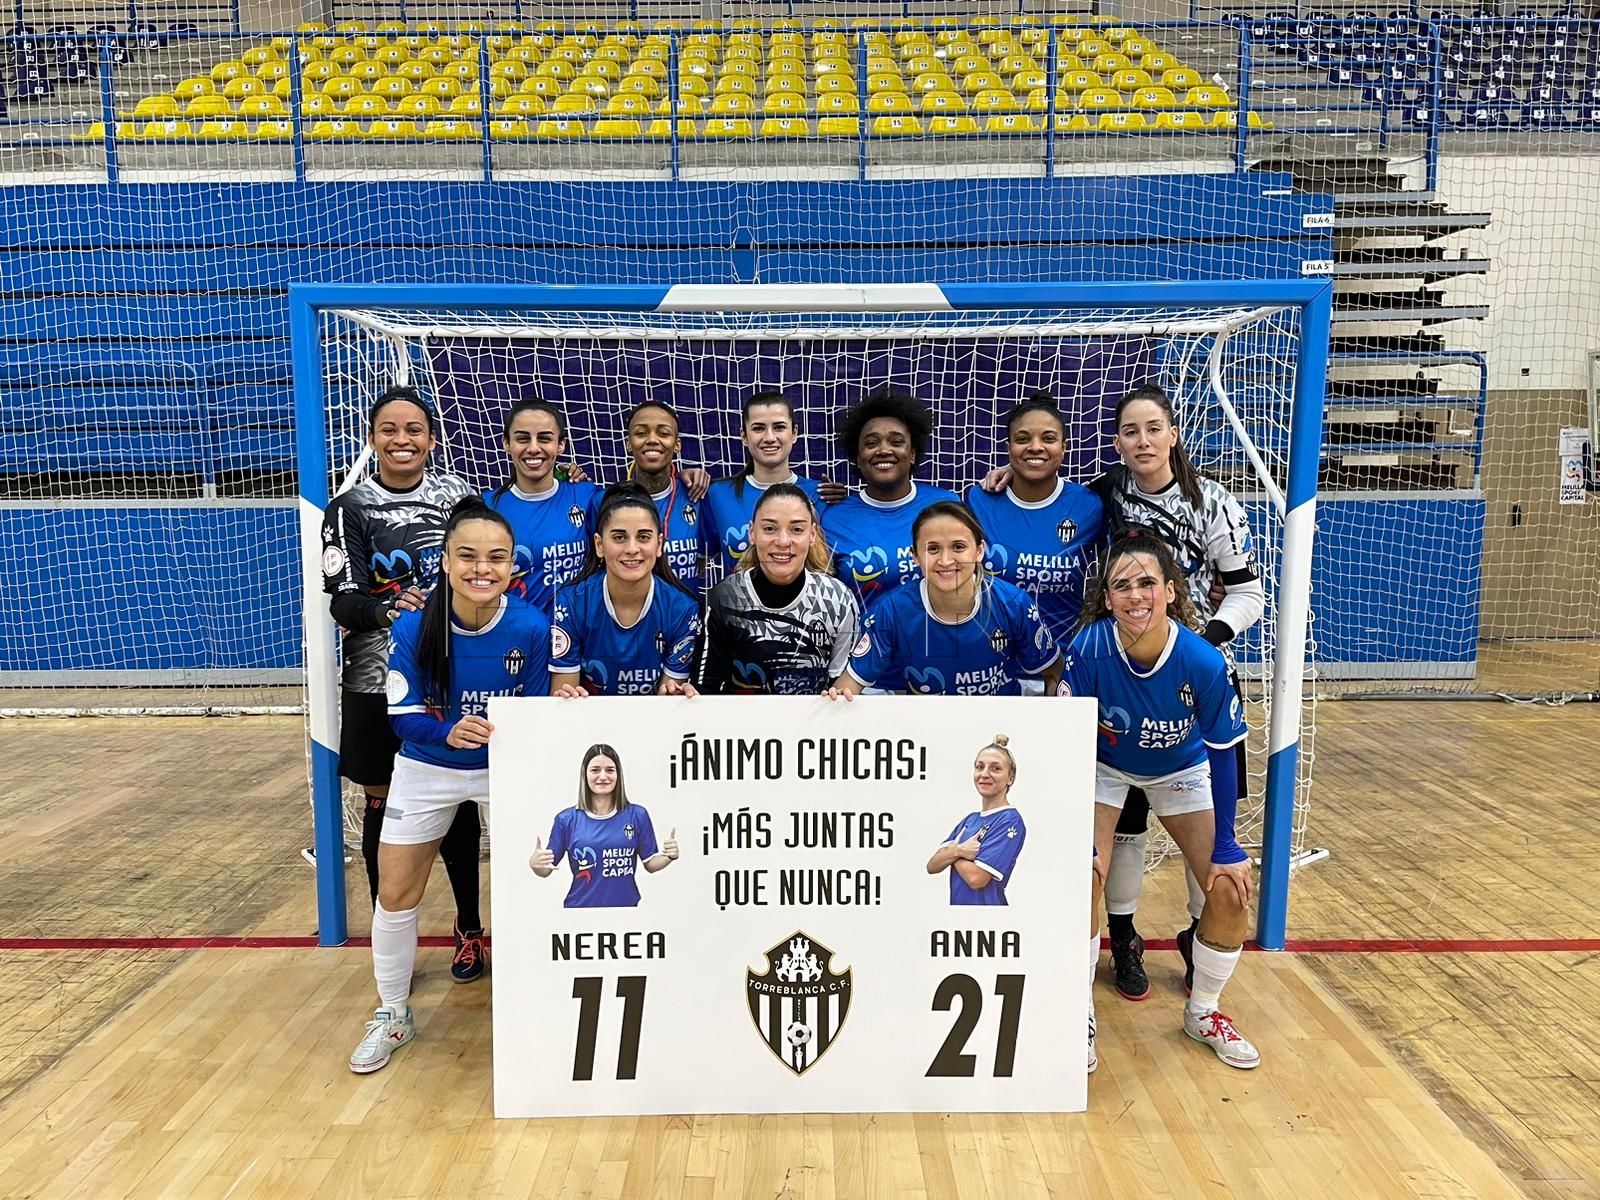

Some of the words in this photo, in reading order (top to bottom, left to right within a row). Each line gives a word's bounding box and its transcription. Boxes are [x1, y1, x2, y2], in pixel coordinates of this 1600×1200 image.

[1016, 567, 1072, 582] SPORT
[1017, 552, 1080, 569] MELILLA
[670, 733, 782, 788] ¡ÁNIMO
[797, 739, 927, 781] CHICAS!
[703, 807, 772, 855] ¡MÁS
[784, 812, 894, 849] JUNTAS
[715, 870, 768, 910] QUE
[780, 870, 881, 906] NUNCA!
[552, 931, 666, 961] NEREA
[931, 930, 1020, 958] ANNA
[748, 979, 825, 995] TORREBLANCA
[830, 980, 850, 991] C.F.
[572, 975, 647, 1082] 11
[924, 973, 1026, 1078] 21
